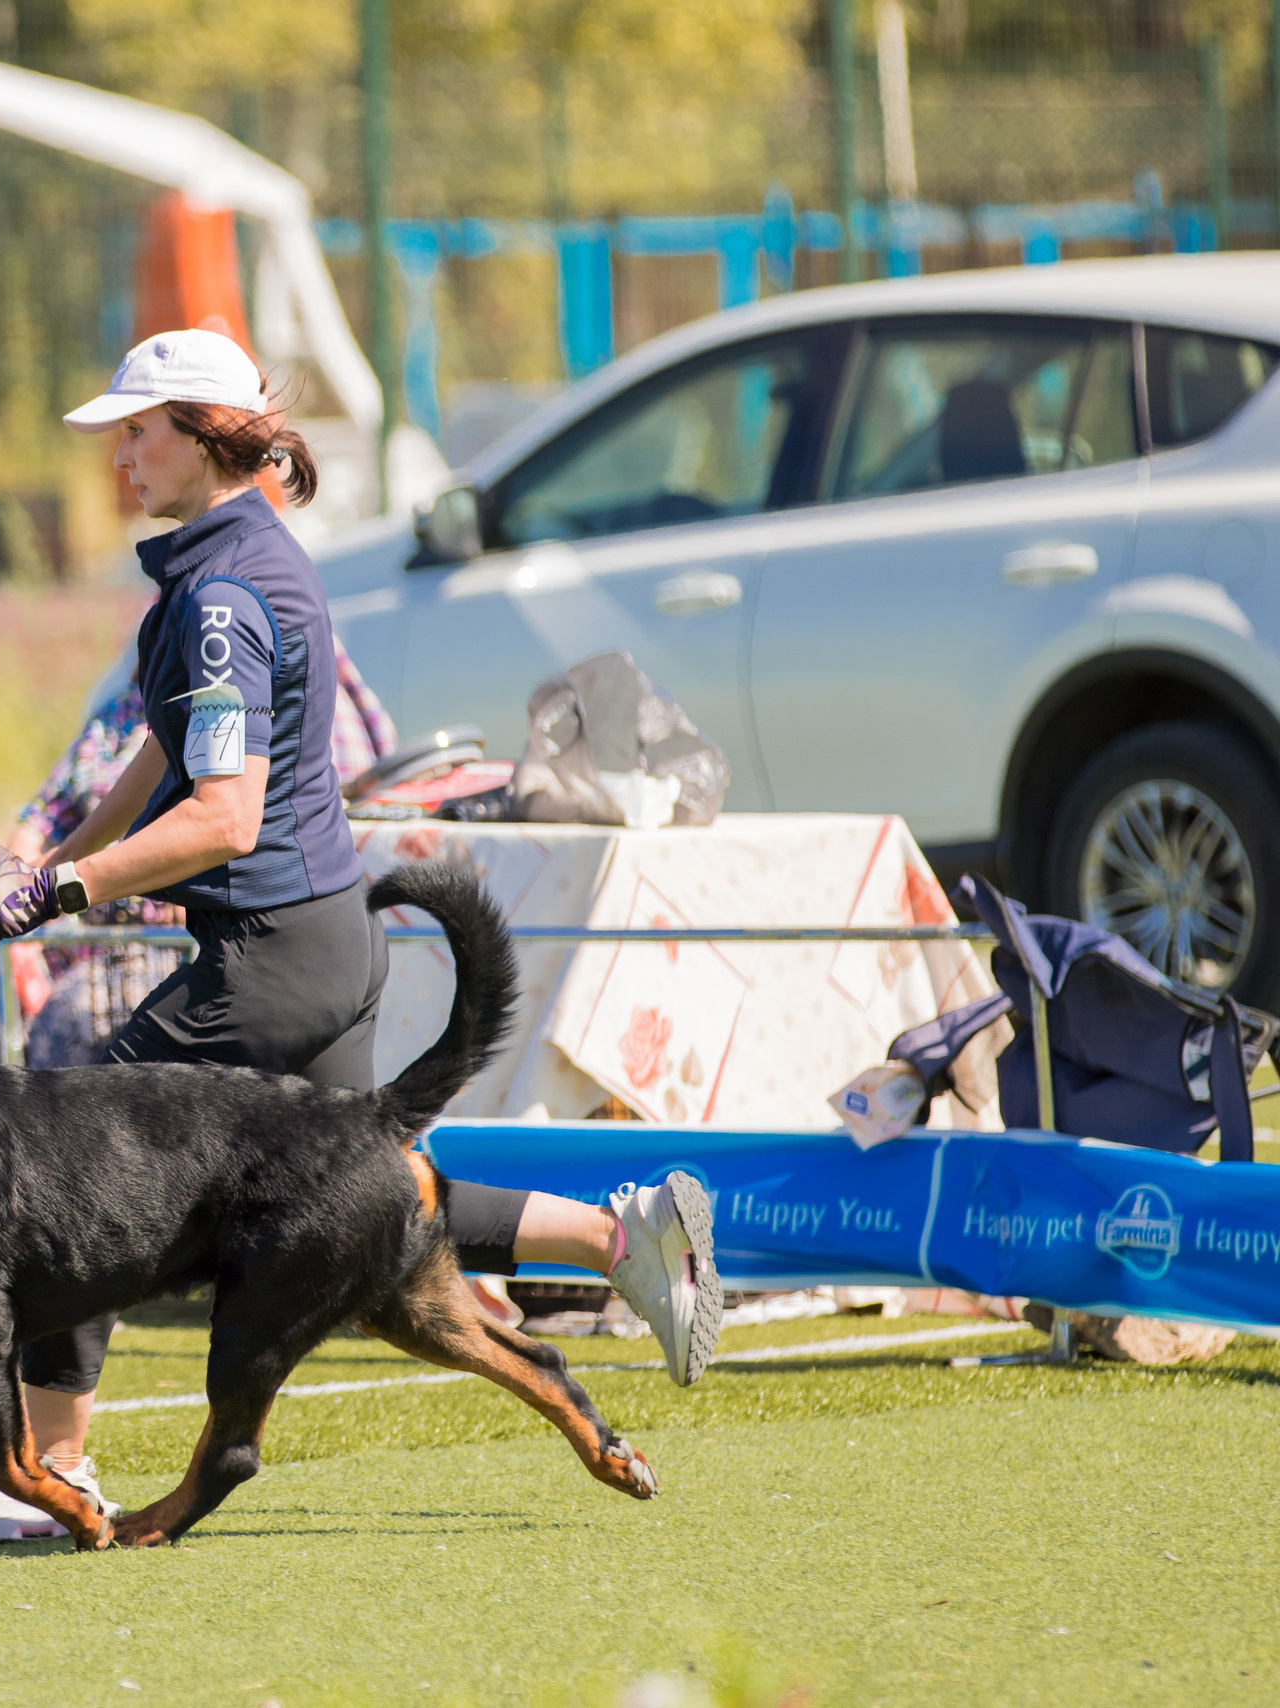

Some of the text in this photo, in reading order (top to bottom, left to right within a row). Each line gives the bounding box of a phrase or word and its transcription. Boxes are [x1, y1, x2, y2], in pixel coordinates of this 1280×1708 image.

[188, 717, 237, 761] 24
[731, 1191, 901, 1237] Happy You.
[963, 1204, 1083, 1249] Happy pet
